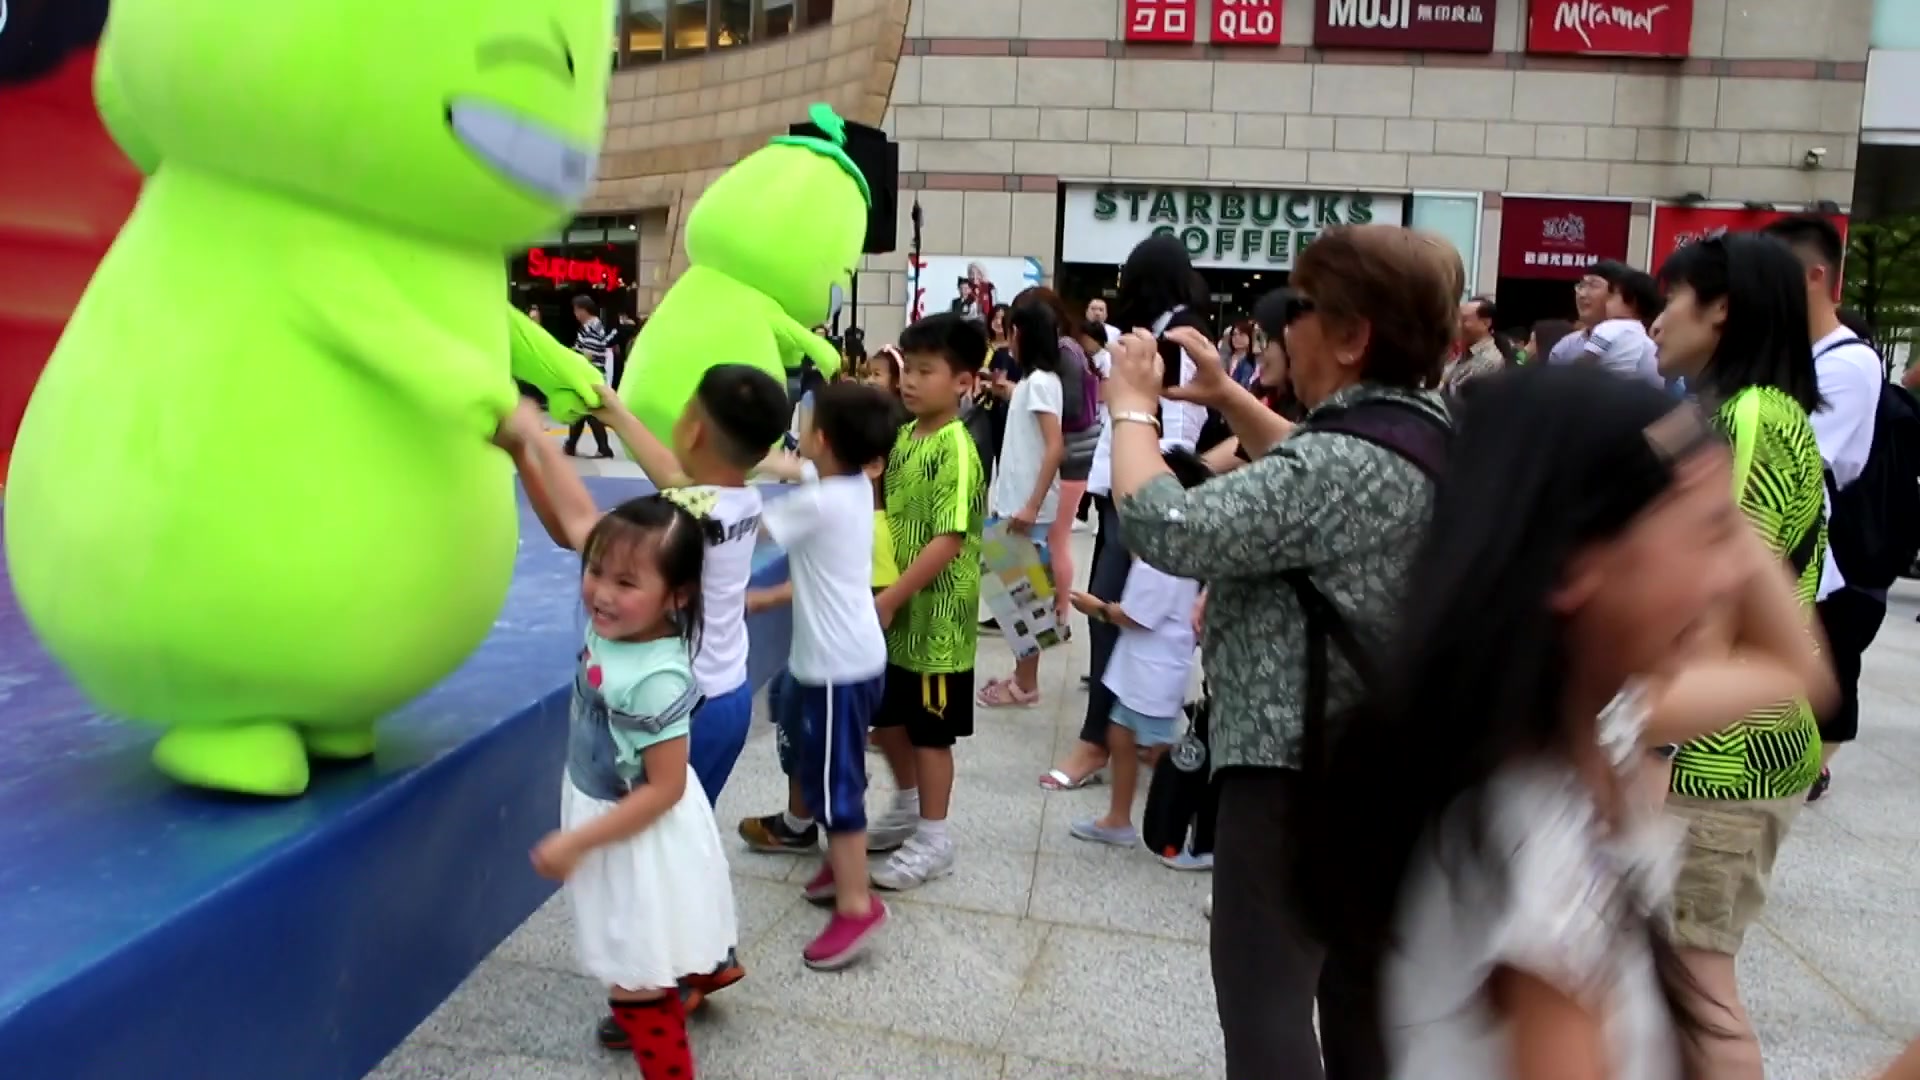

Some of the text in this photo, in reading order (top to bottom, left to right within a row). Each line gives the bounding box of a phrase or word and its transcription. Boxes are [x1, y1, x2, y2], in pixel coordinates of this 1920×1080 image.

[1218, 9, 1275, 39] QLO
[1328, 0, 1411, 29] MUJI
[1094, 188, 1374, 227] STARBUCKS
